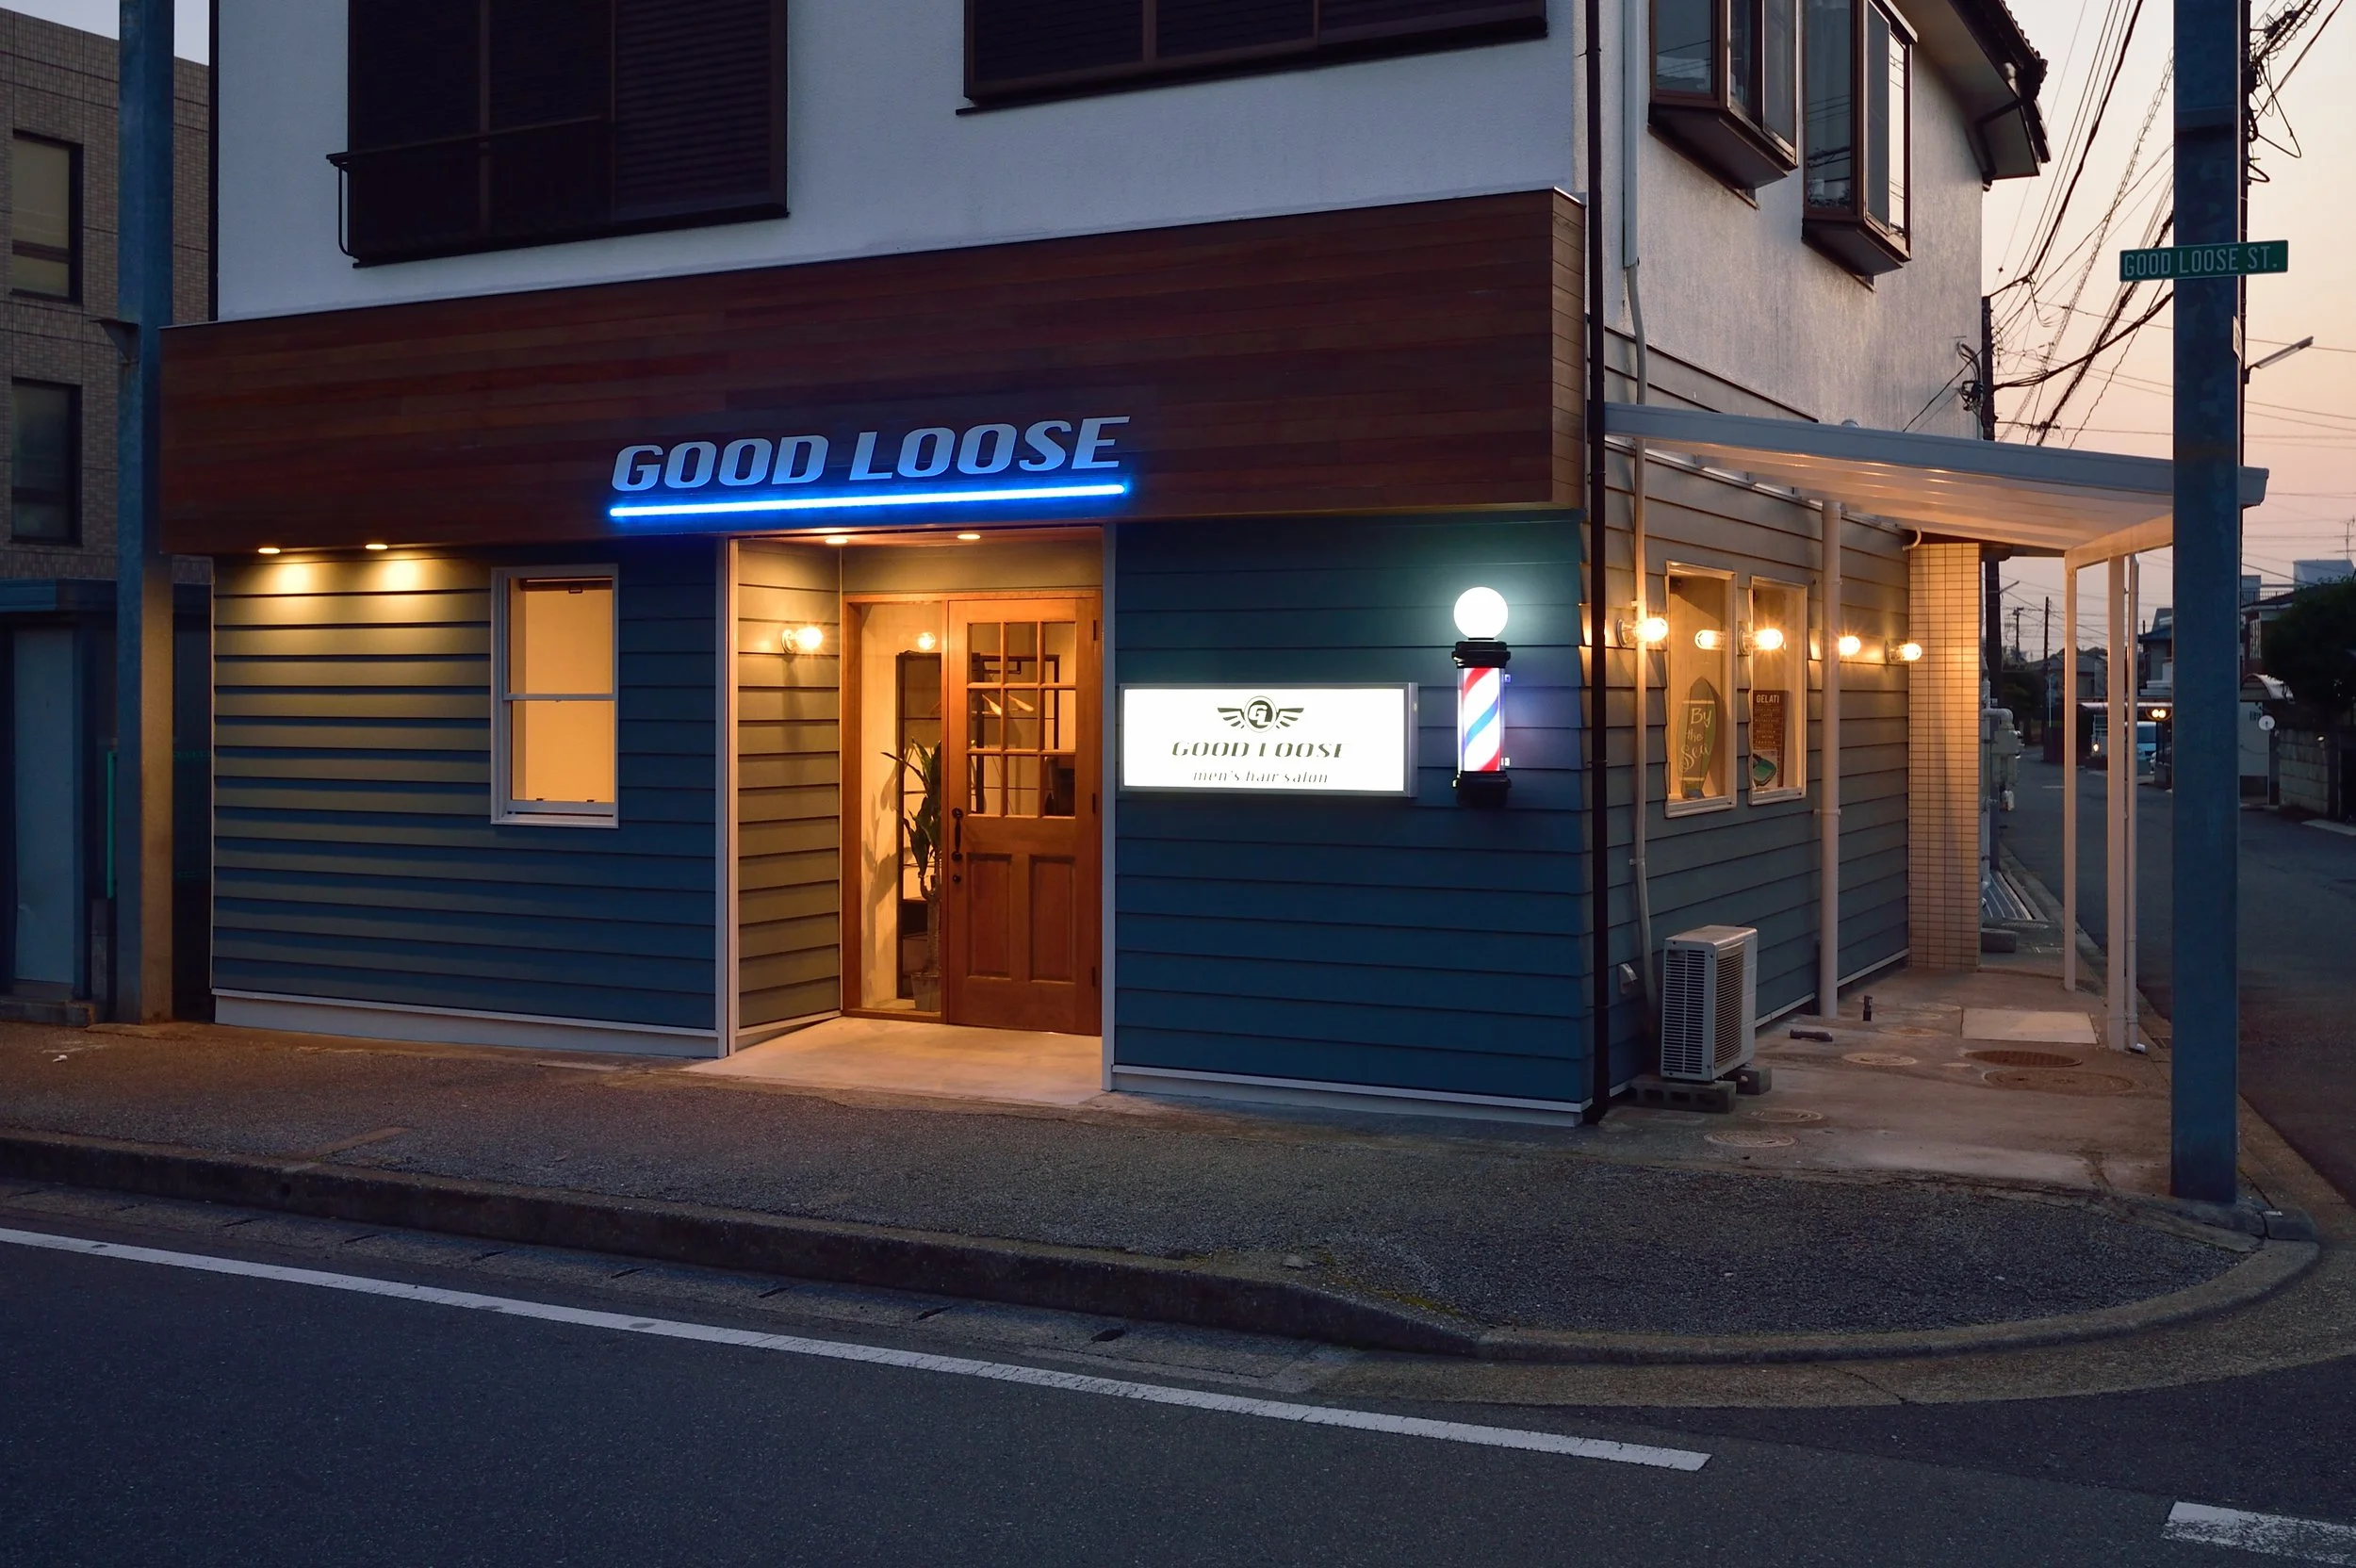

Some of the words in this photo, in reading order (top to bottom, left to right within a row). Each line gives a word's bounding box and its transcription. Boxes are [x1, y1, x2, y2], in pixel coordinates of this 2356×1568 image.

[2124, 252, 2171, 277] GOOD
[2179, 248, 2239, 274] LOOSE
[2247, 245, 2278, 270] ST.
[611, 433, 830, 492] GOOD
[848, 416, 1130, 481] LOOSE
[1756, 694, 1780, 704] GELATI
[1691, 708, 1711, 728] By
[1686, 728, 1704, 743] the
[1171, 742, 1250, 757] GOOD
[1678, 743, 1711, 773] Sea
[1193, 770, 1240, 782] men's
[1245, 771, 1280, 783] hair
[1284, 771, 1329, 784] salon
